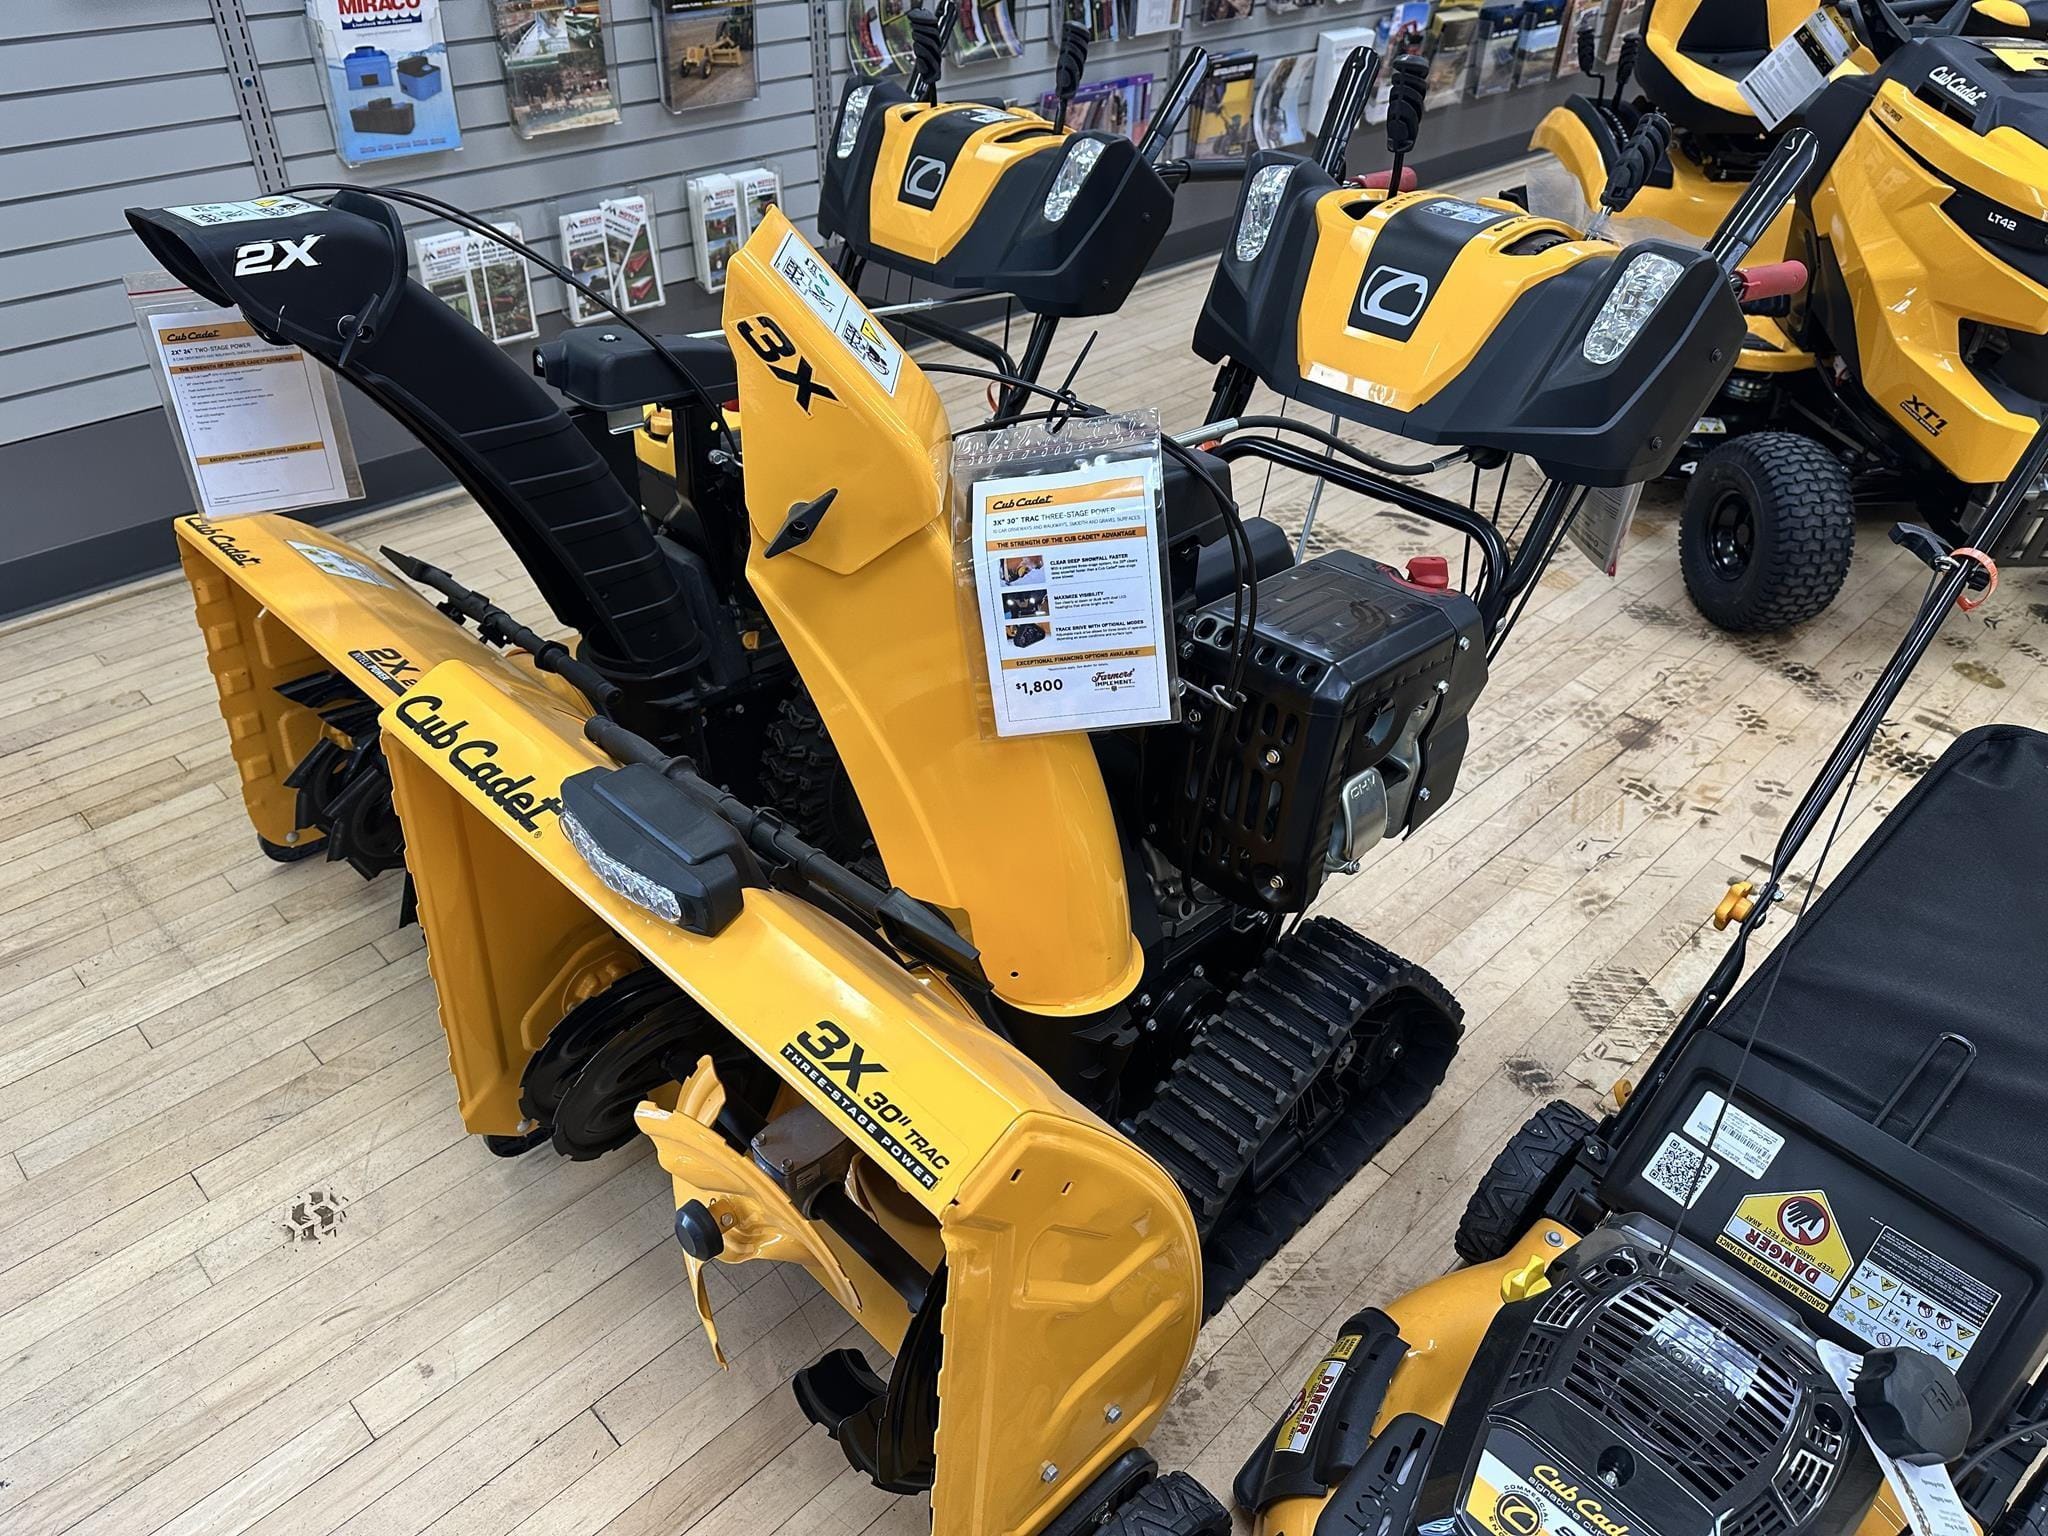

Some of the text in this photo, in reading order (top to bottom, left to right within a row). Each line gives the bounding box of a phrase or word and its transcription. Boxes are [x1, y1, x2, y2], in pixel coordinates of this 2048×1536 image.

[338, 0, 421, 14] MIRACO
[1928, 66, 1987, 106] Cub Cadet
[579, 216, 602, 224] NOTCH
[619, 210, 640, 222] NOTCH
[1987, 211, 2017, 231] LT42
[234, 233, 326, 277] 2X
[167, 330, 220, 342] Cub Cadet
[737, 316, 840, 412] 3X
[1904, 394, 1948, 430] XT1
[993, 495, 1053, 510] Cub Cadet
[1021, 515, 1039, 523] TRAC
[1041, 510, 1089, 521] THREE-STAGE
[1091, 507, 1115, 515] POWER
[185, 517, 261, 568] Cub Cadet
[1010, 539, 1040, 547] STRENGTH
[1102, 530, 1136, 538] ADVANTAGE
[364, 648, 421, 676] 2X
[1016, 658, 1053, 666] EXCEPTIONAL
[1055, 655, 1084, 663] FINANCING
[1015, 679, 1063, 695] $1,800
[396, 695, 469, 749] Cub
[797, 1020, 950, 1170] 3X 30" TRAC
[784, 1047, 935, 1187] THREE-STAGE POWER
[1718, 1237, 1748, 1260] DISTANCE
[1744, 1228, 1822, 1284] DANGER
[1745, 1215, 1836, 1274] KEEP HANDS and FEET AWAY
[1752, 1259, 1773, 1275] PIEDS
[1778, 1276, 1799, 1293] MAINS
[1798, 1288, 1826, 1310] GARDER
[1659, 1338, 1726, 1394] KOHLER
[1296, 1375, 1334, 1435] DANGER
[1504, 1484, 1549, 1523] COMMERCIAL
[1527, 1476, 1581, 1520] signature
[1534, 1465, 1630, 1536] Cub Cad
